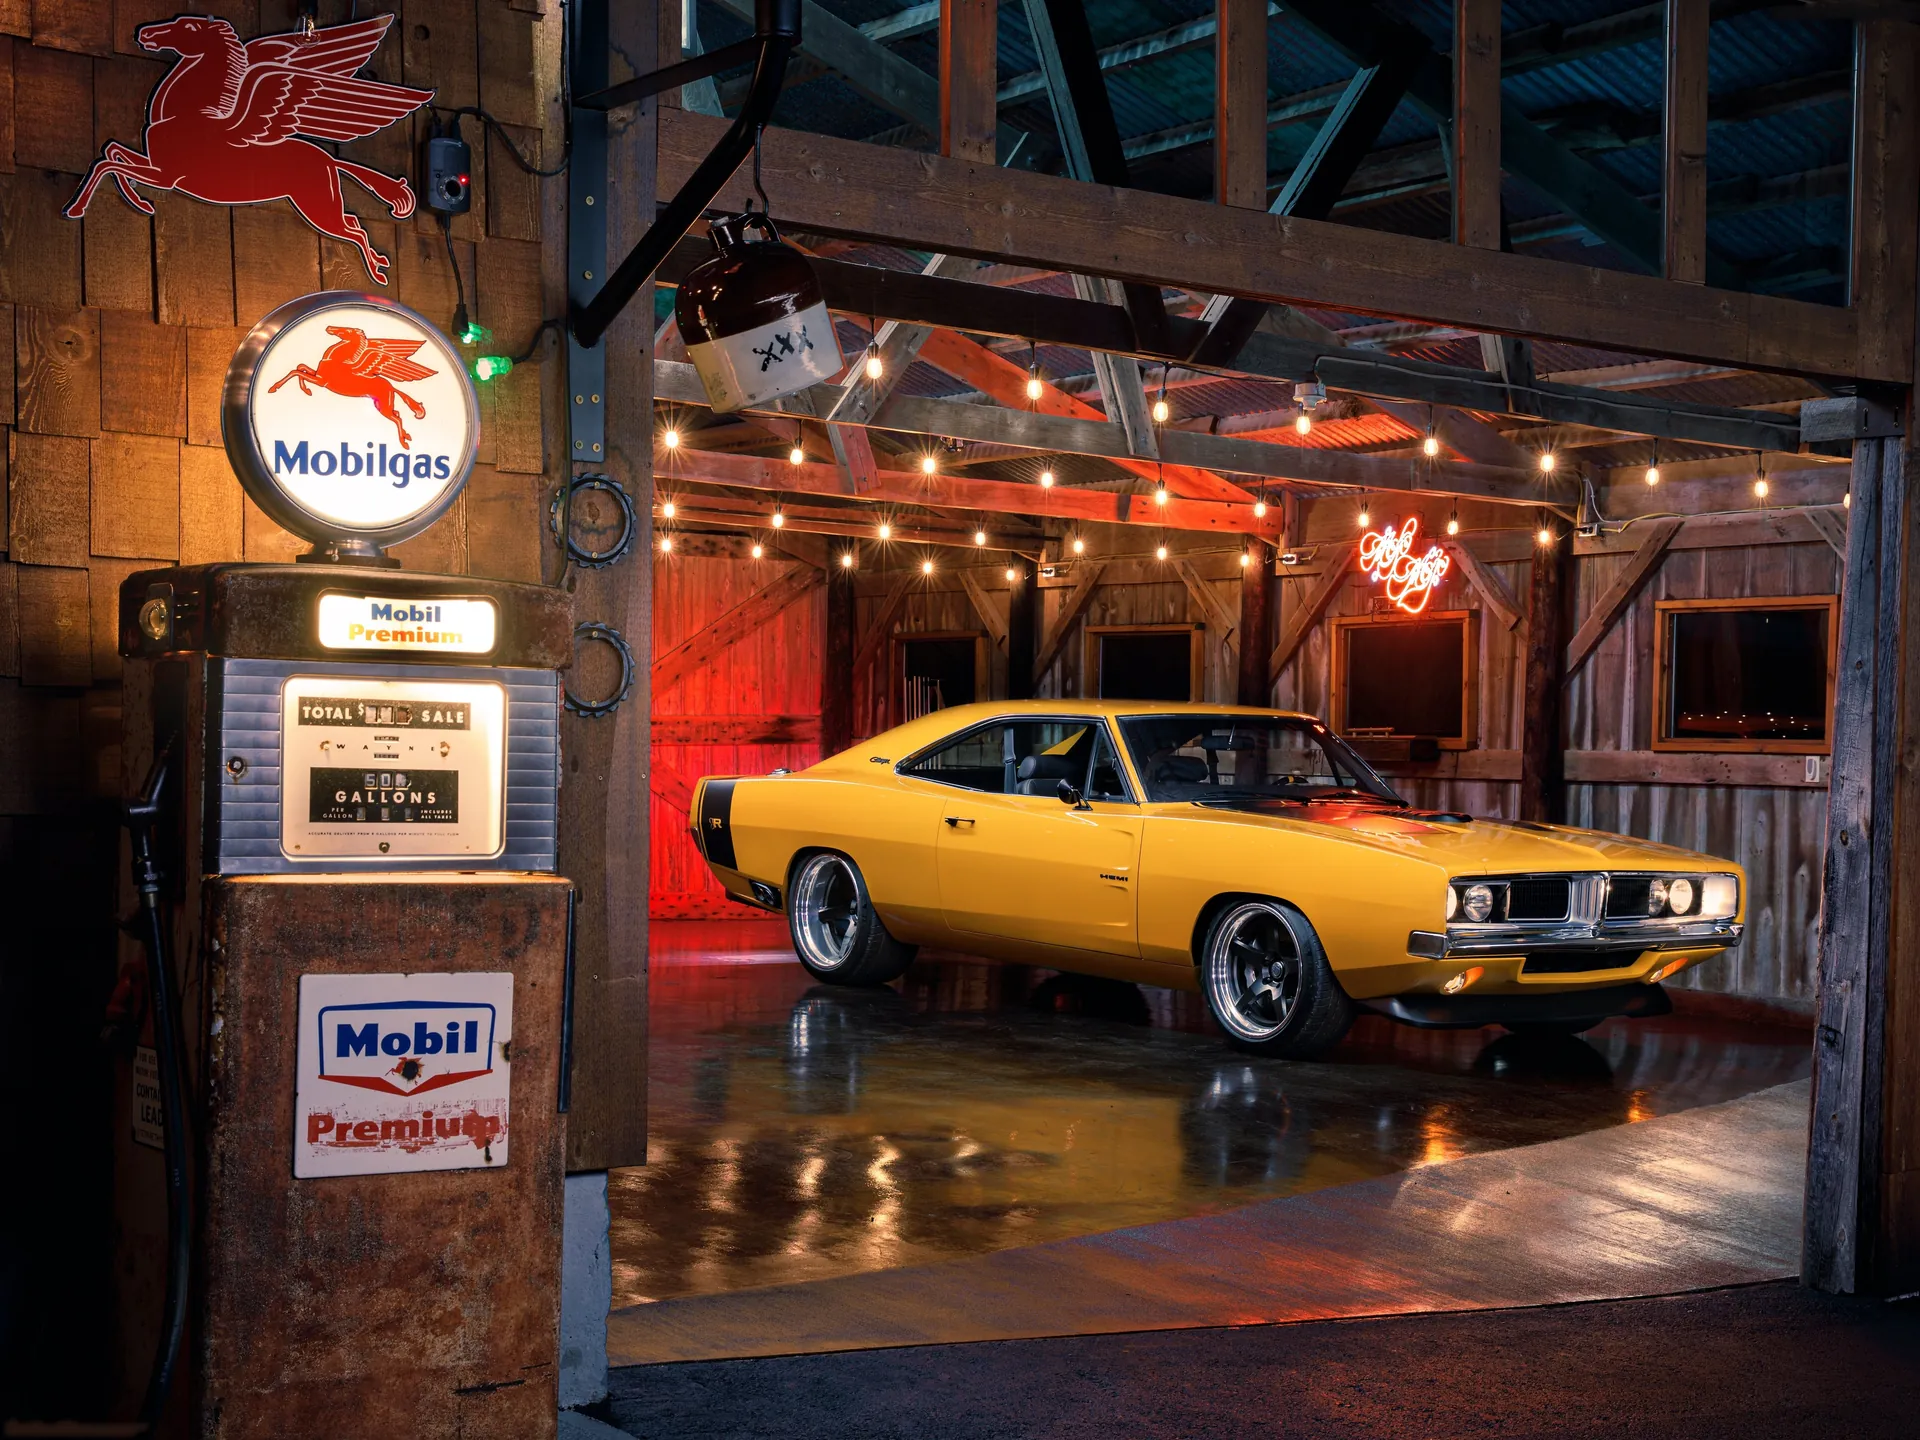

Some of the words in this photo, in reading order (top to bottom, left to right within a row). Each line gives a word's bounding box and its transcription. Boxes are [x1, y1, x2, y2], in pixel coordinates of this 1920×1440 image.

[274, 440, 451, 489] Mobilgas
[371, 603, 441, 623] Mobil
[348, 622, 463, 643] Premium
[302, 706, 353, 720] TOTAL
[421, 710, 464, 724] SALE
[336, 744, 434, 752] WAYNE
[335, 790, 436, 804] GALLONS
[1100, 874, 1128, 882] HEMI
[336, 1021, 478, 1058] Mobil
[142, 1102, 164, 1126] LEAD
[307, 1111, 501, 1143] Premium
